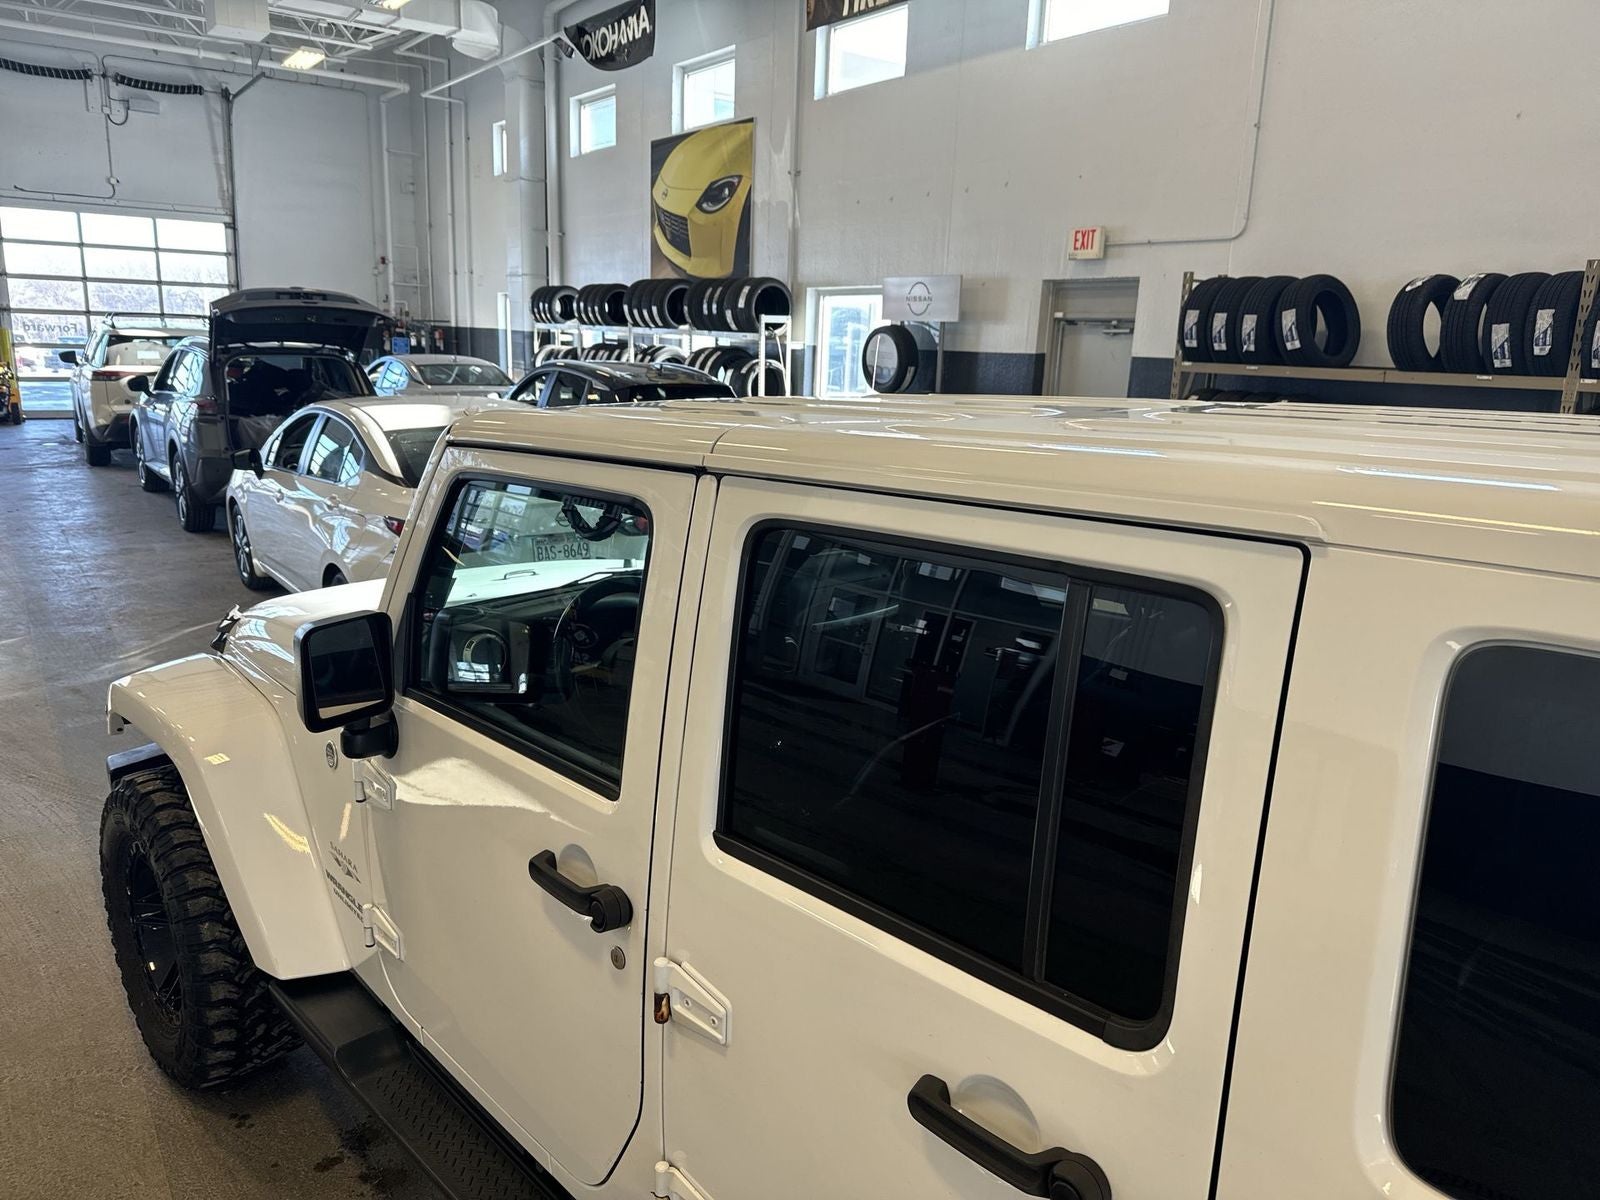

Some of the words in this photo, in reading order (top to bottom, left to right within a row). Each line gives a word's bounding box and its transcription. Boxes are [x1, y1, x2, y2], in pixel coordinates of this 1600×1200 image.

[581, 5, 652, 60] OKOHAMA
[1073, 229, 1097, 251] EXIT
[536, 542, 589, 561] BAS-8649
[325, 868, 364, 914] WRANGLE
